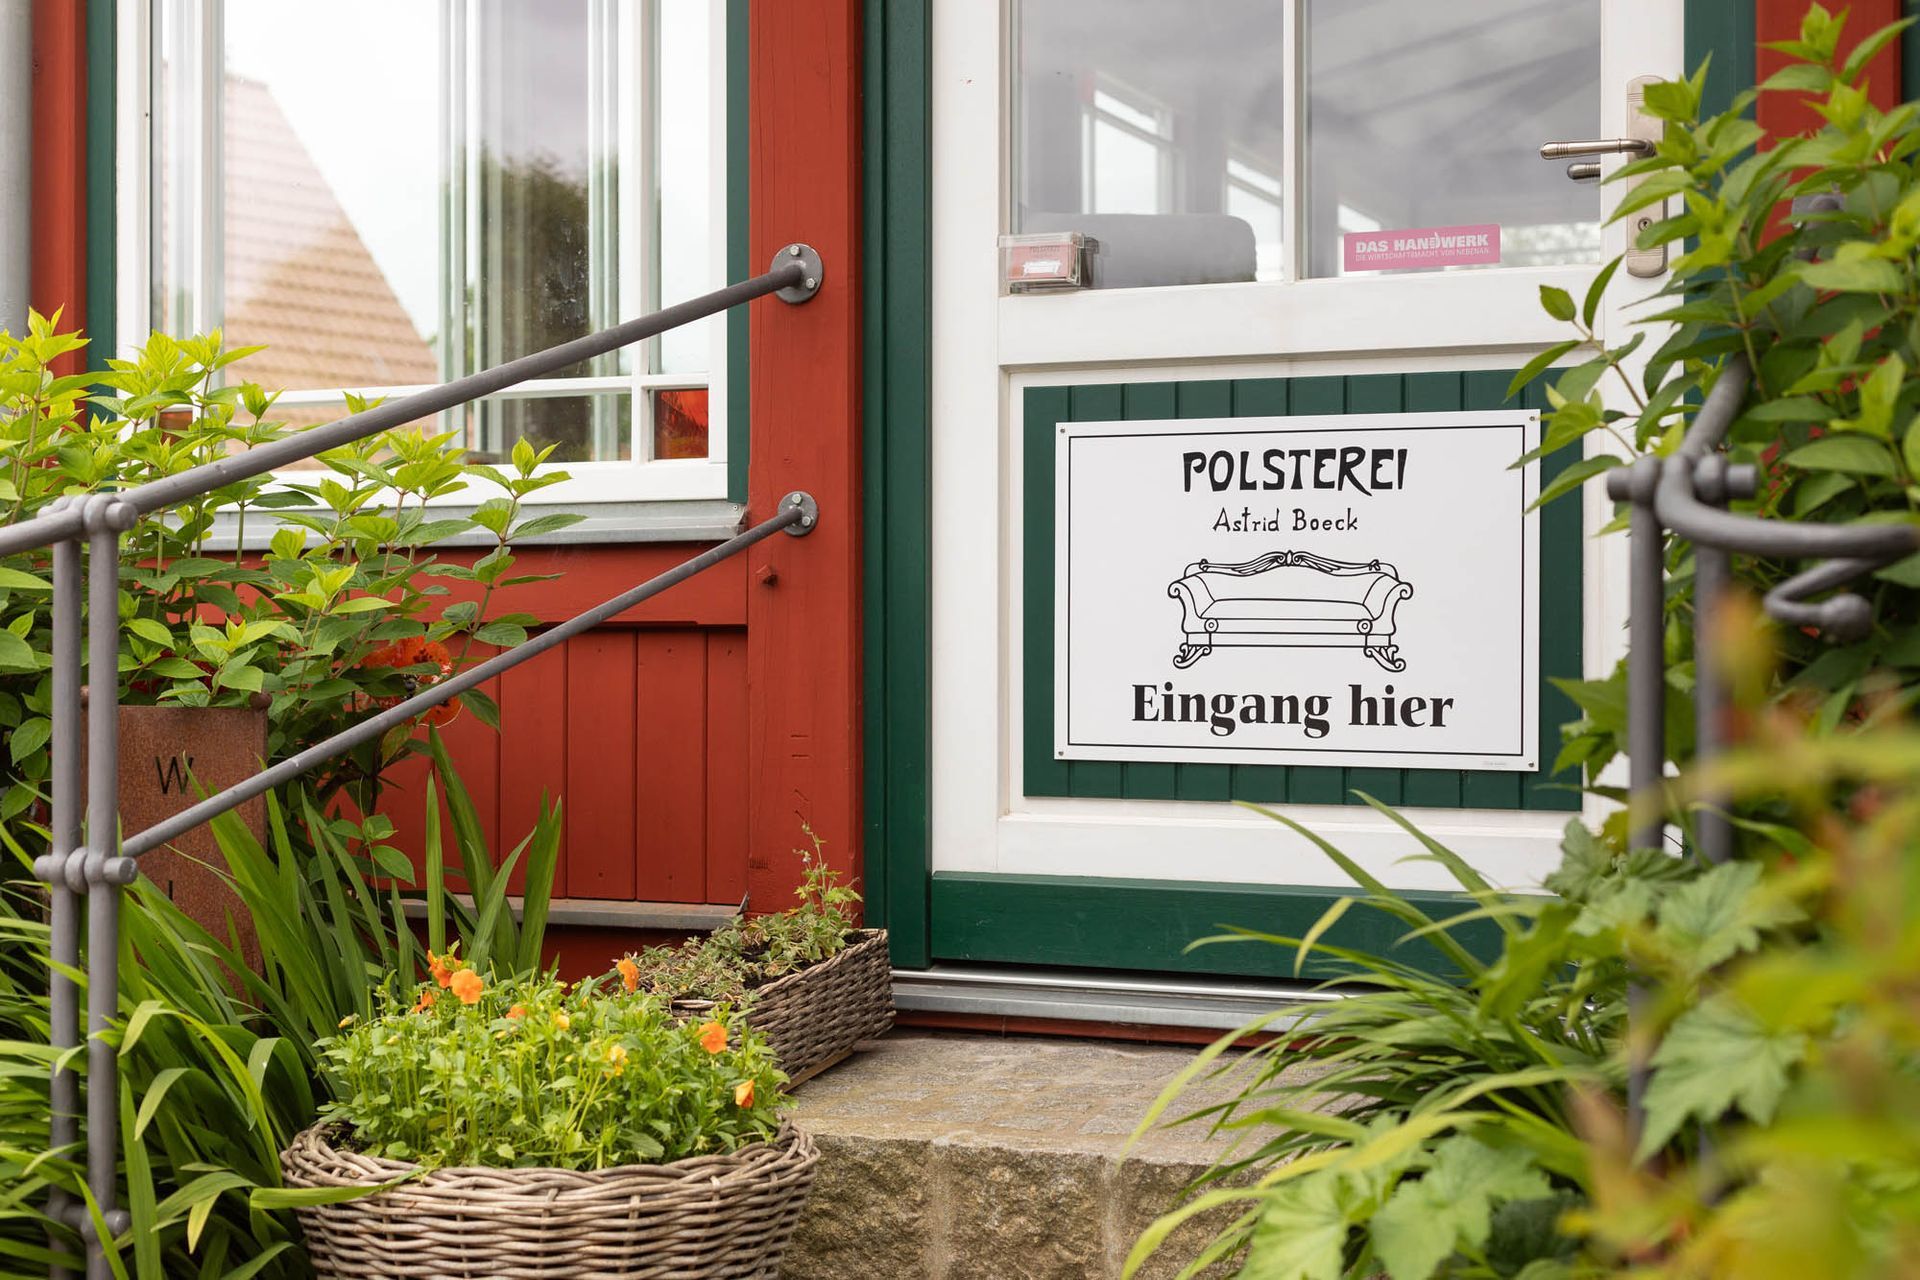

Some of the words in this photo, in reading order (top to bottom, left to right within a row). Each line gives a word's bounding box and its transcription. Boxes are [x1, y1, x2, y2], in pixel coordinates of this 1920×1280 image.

[1356, 240, 1389, 253] DAS
[1394, 232, 1489, 250] HANDWERK
[1182, 446, 1408, 497] POLSTEREI
[1212, 506, 1280, 533] Astrid
[1292, 507, 1358, 532] Boeck
[1131, 681, 1333, 739] Eingang
[1348, 684, 1454, 728] hier
